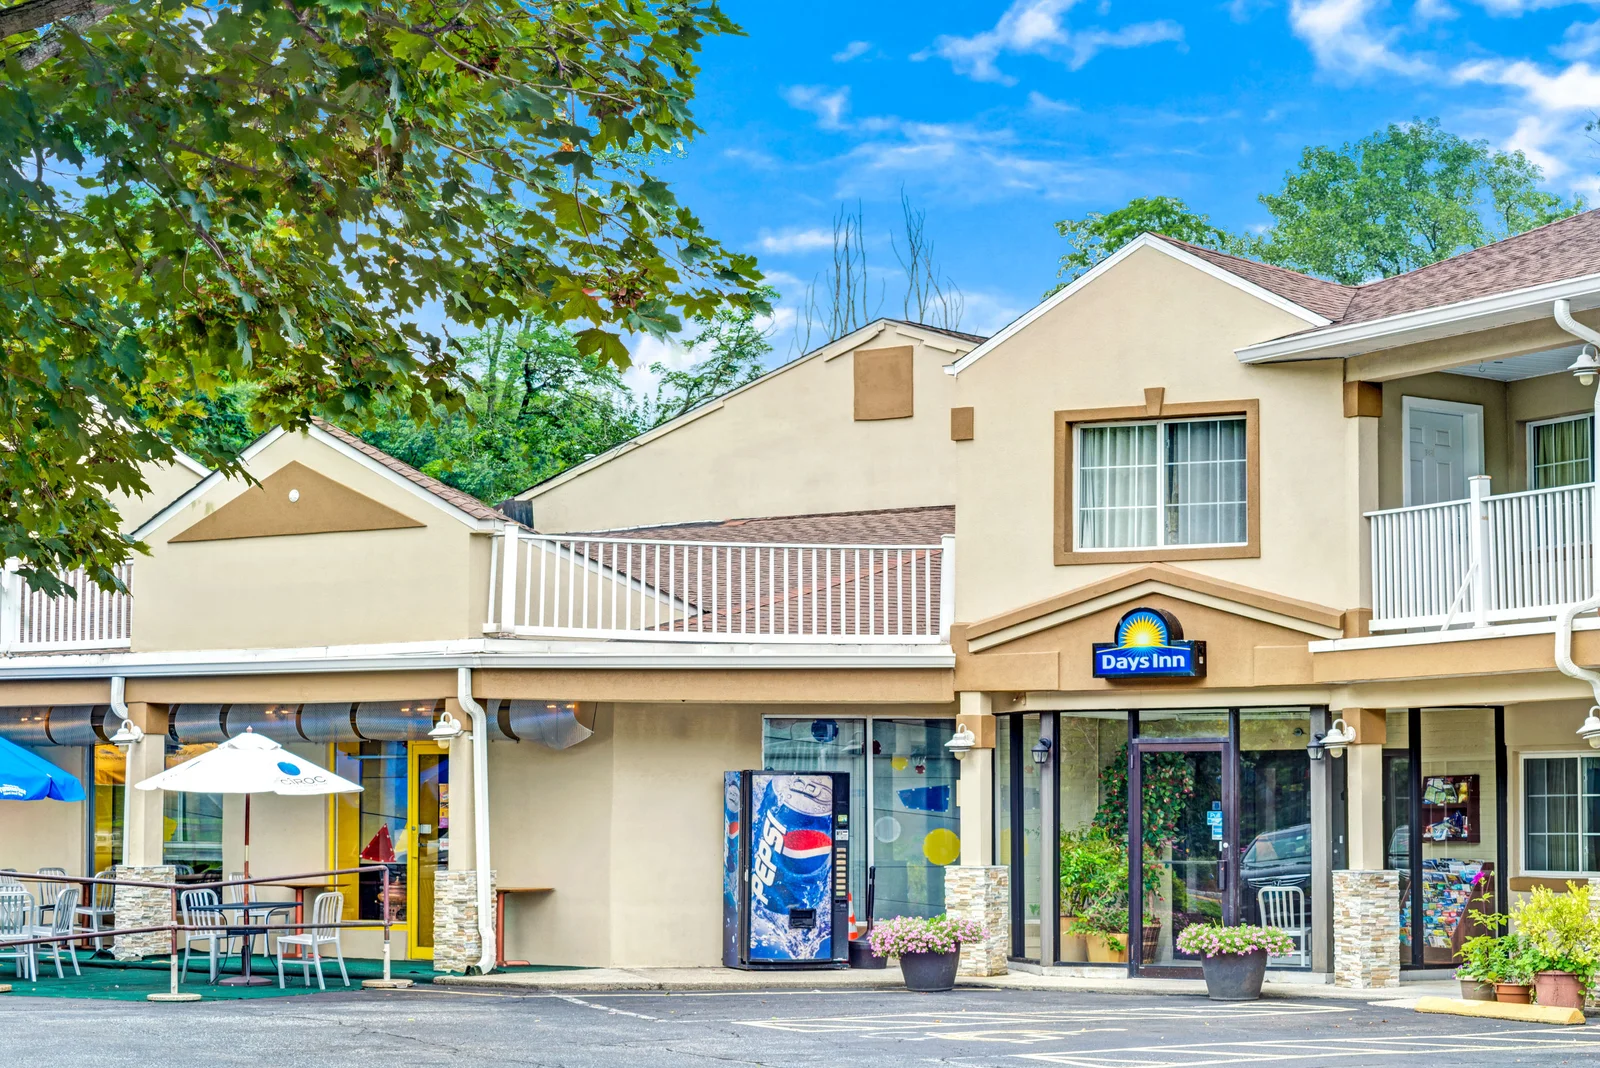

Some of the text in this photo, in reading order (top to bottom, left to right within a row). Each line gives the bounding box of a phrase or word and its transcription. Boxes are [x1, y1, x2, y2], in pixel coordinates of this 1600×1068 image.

[1102, 653, 1185, 671] Days Inn
[751, 809, 788, 906] PEPSI
